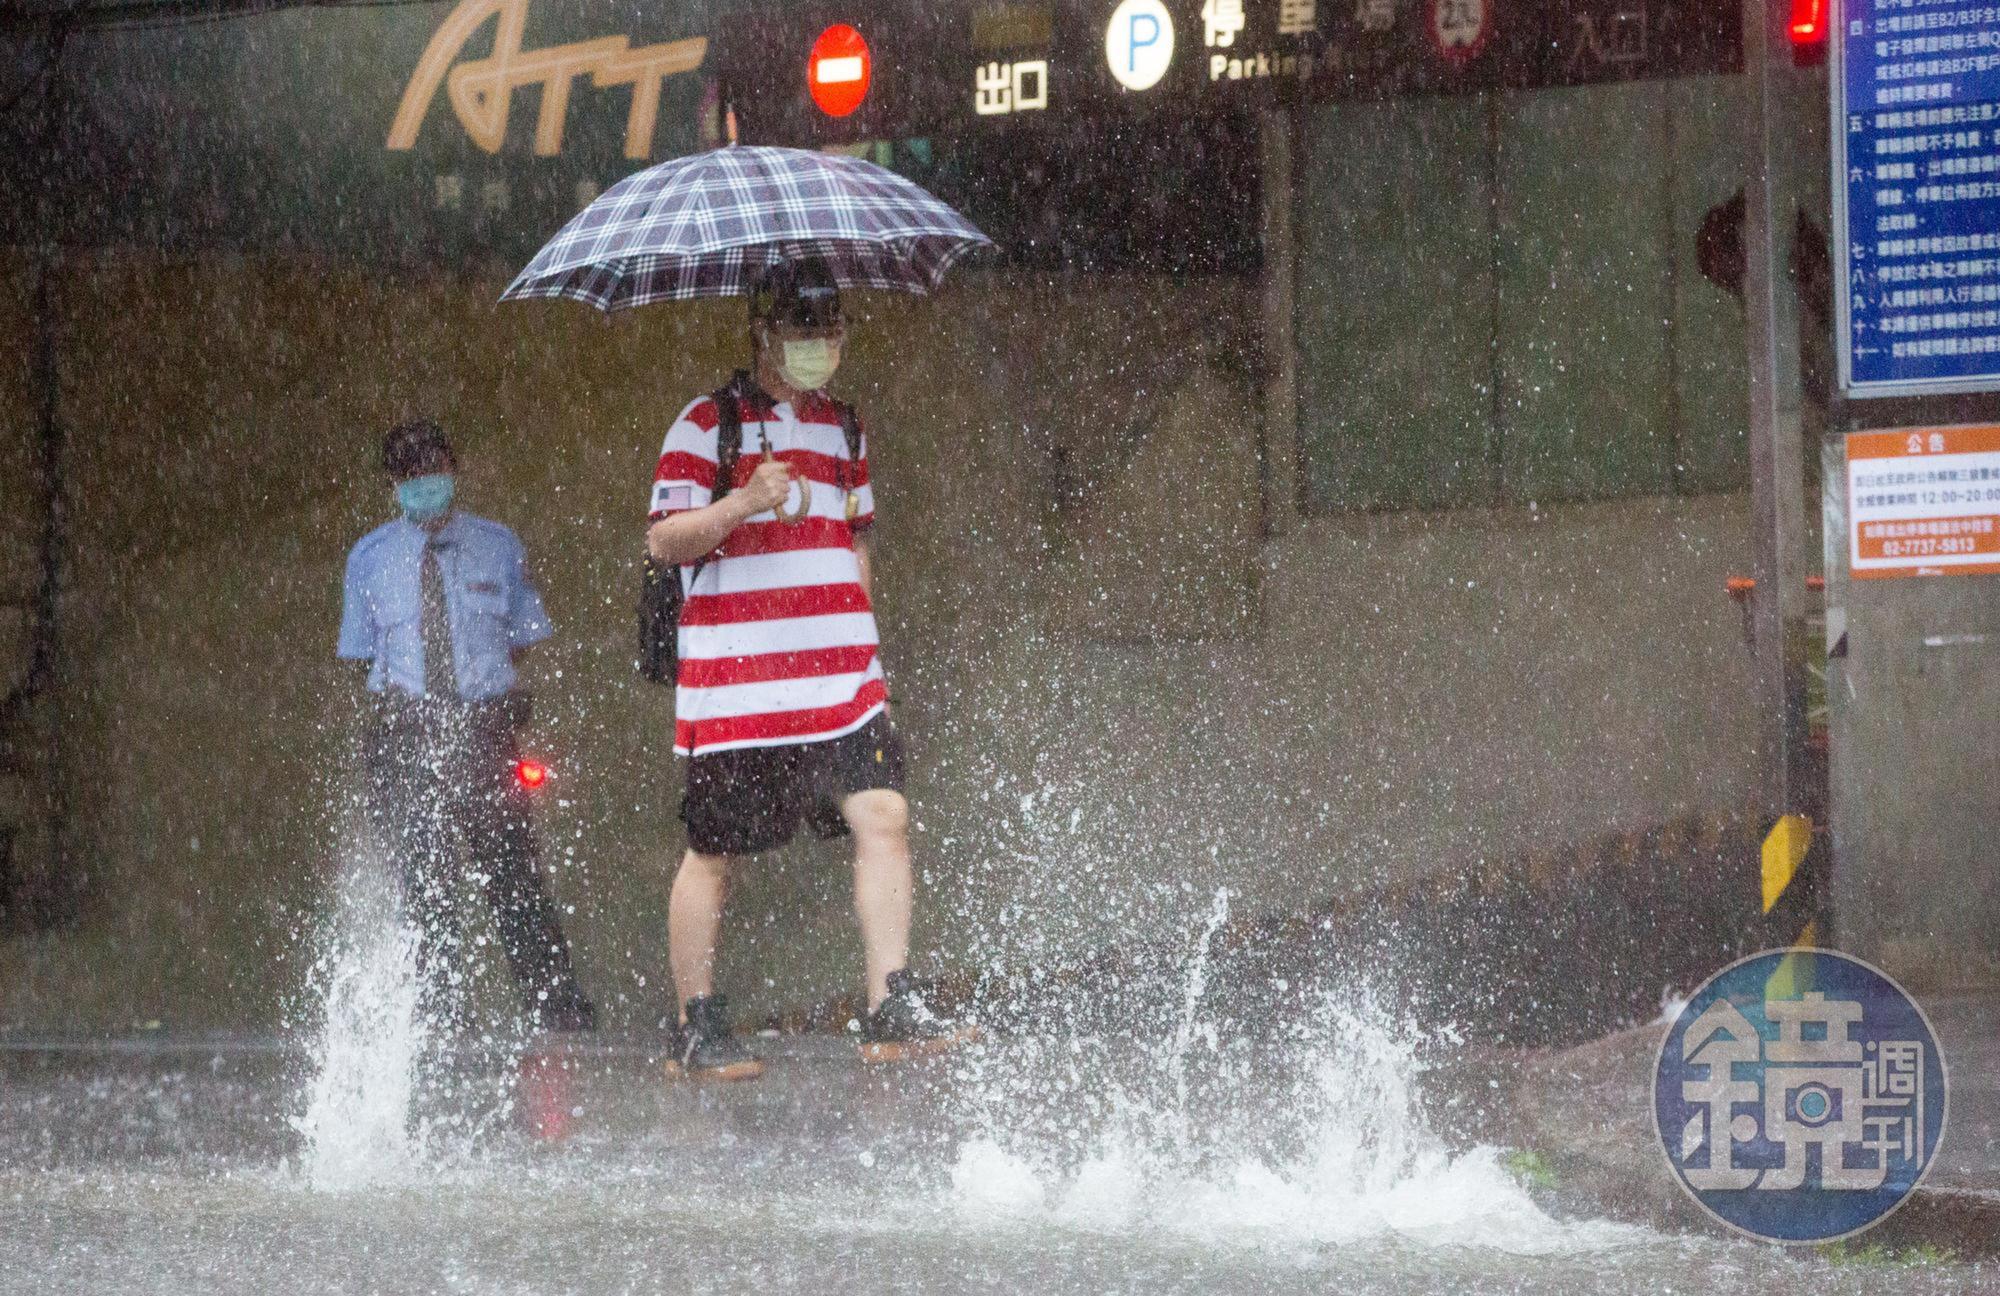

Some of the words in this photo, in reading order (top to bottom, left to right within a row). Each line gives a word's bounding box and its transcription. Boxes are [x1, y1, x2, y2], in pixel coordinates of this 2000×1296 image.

[1129, 13, 1160, 73] P
[975, 60, 1048, 115] 出口
[1209, 51, 1314, 82] Parking
[1907, 432, 1945, 454] 公告
